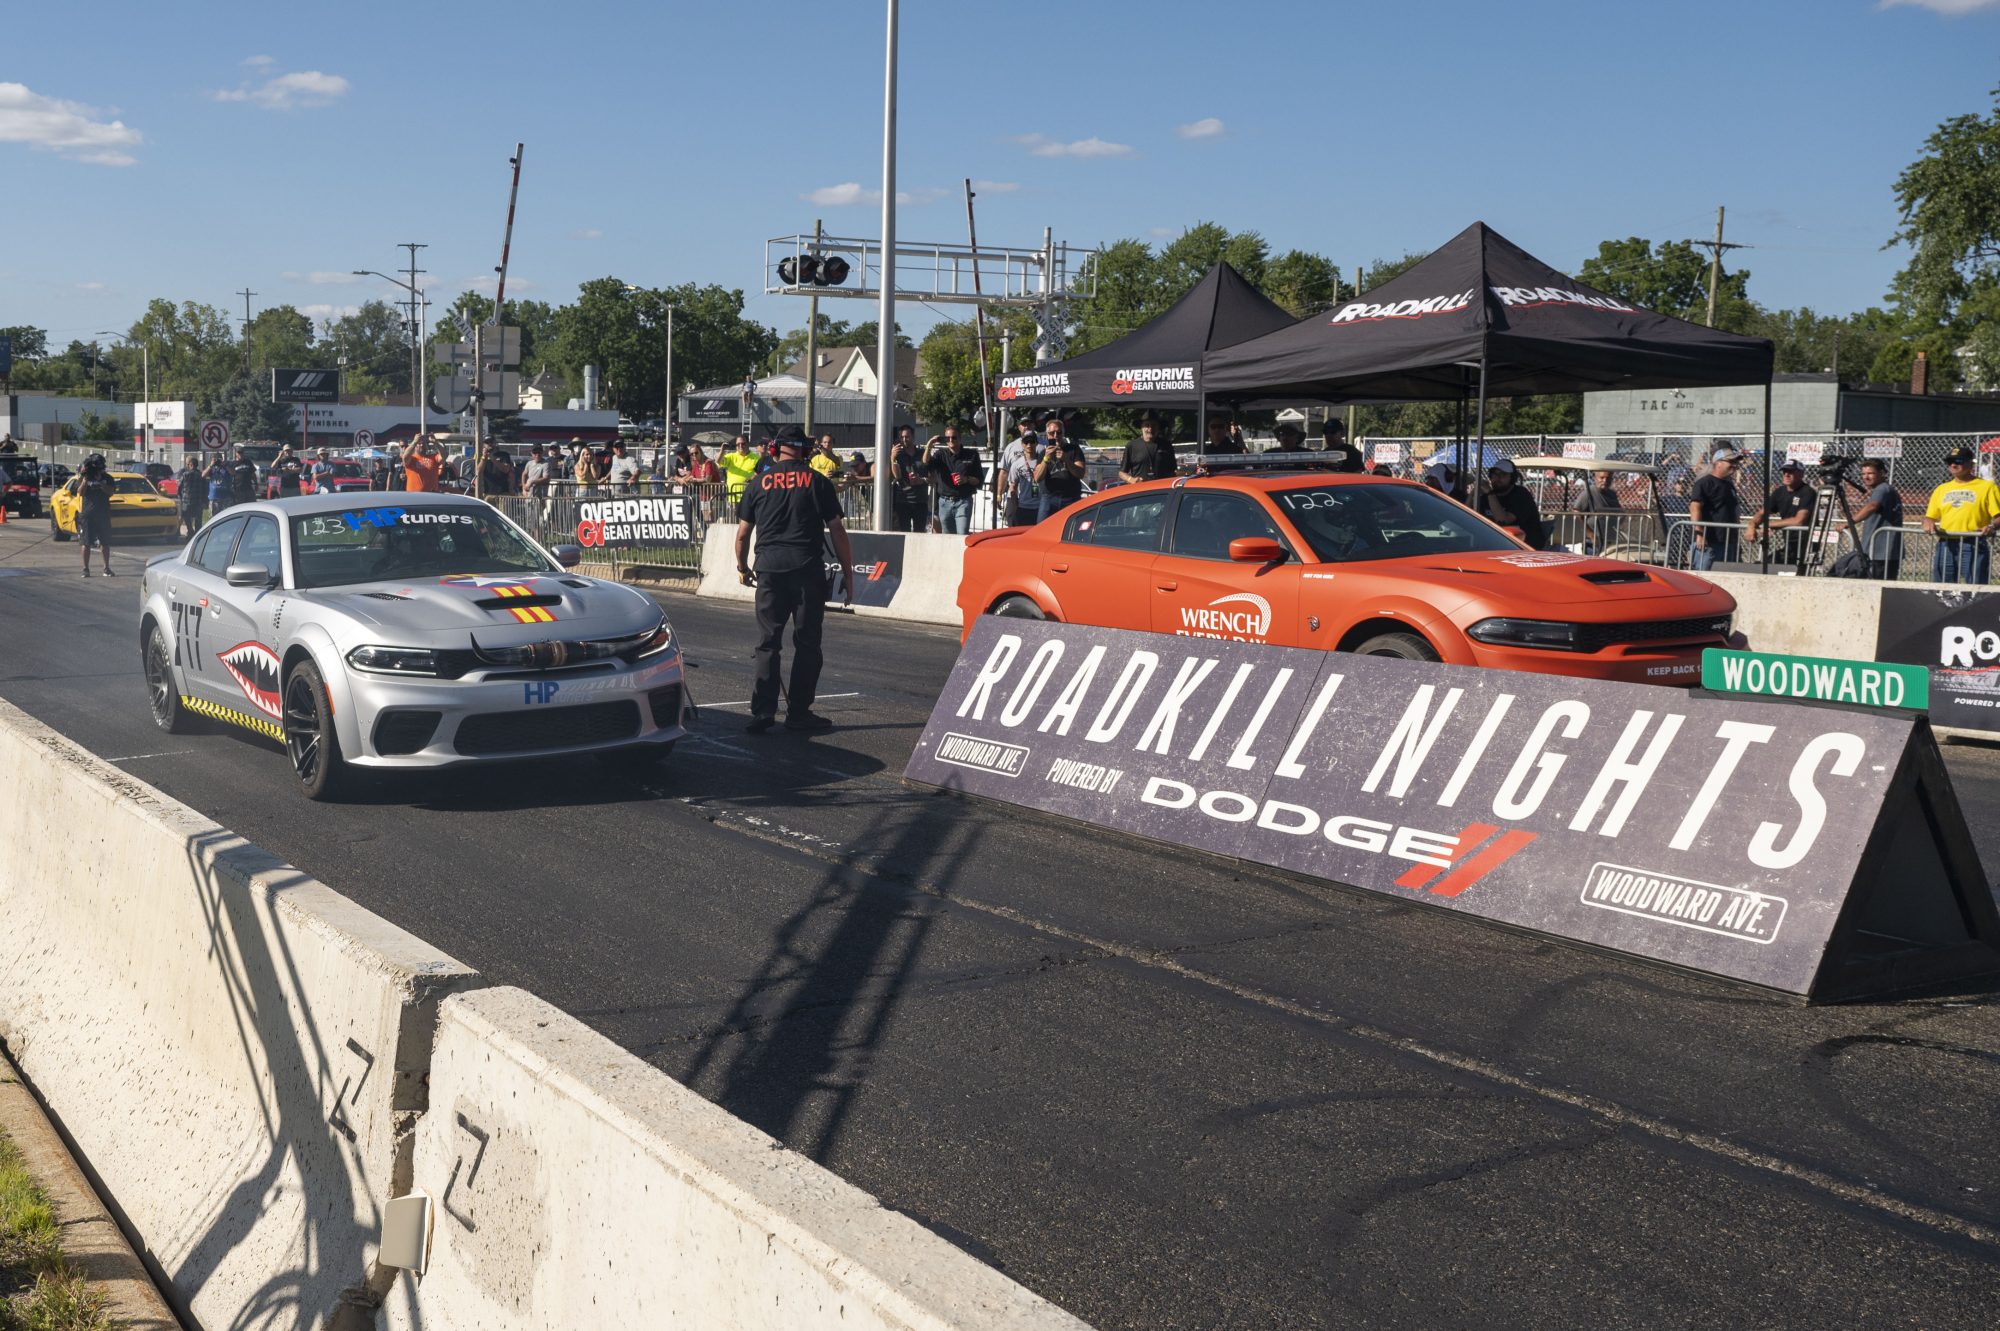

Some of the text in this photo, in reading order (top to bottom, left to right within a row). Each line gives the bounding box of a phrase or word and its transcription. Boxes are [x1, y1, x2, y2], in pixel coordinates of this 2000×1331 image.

[1332, 288, 1475, 323] ROADKILL
[1489, 286, 1632, 312] ROADKILL
[1002, 373, 1069, 388] OVERDRIVE
[1116, 368, 1193, 381] OVERDRIVE
[1132, 380, 1194, 391] GEAR VENDORS
[1015, 384, 1071, 397] GEAR VENDORS
[761, 472, 813, 491] CREW
[580, 499, 686, 523] OVERDRIVE
[1283, 492, 1344, 510] 122
[342, 507, 406, 531] HP
[400, 513, 473, 524] tuners
[603, 523, 690, 541] GEAR VENDORS
[1181, 607, 1261, 635] WRENCH
[172, 601, 203, 672] 717
[1647, 666, 1671, 676] KEEP
[1672, 664, 1695, 675] BACK
[1722, 656, 1906, 708] WOODWARD
[524, 682, 560, 705] HP
[1954, 697, 1994, 708] POWERED
[956, 634, 1345, 780] ROADKILL
[941, 735, 1023, 772] WOODWARD AVE.
[1045, 757, 1125, 795] POWERED BY
[1361, 684, 1866, 870] NIGHTS
[1141, 776, 1461, 868] DODGE
[1592, 869, 1771, 935] WOODWARD AVE.
